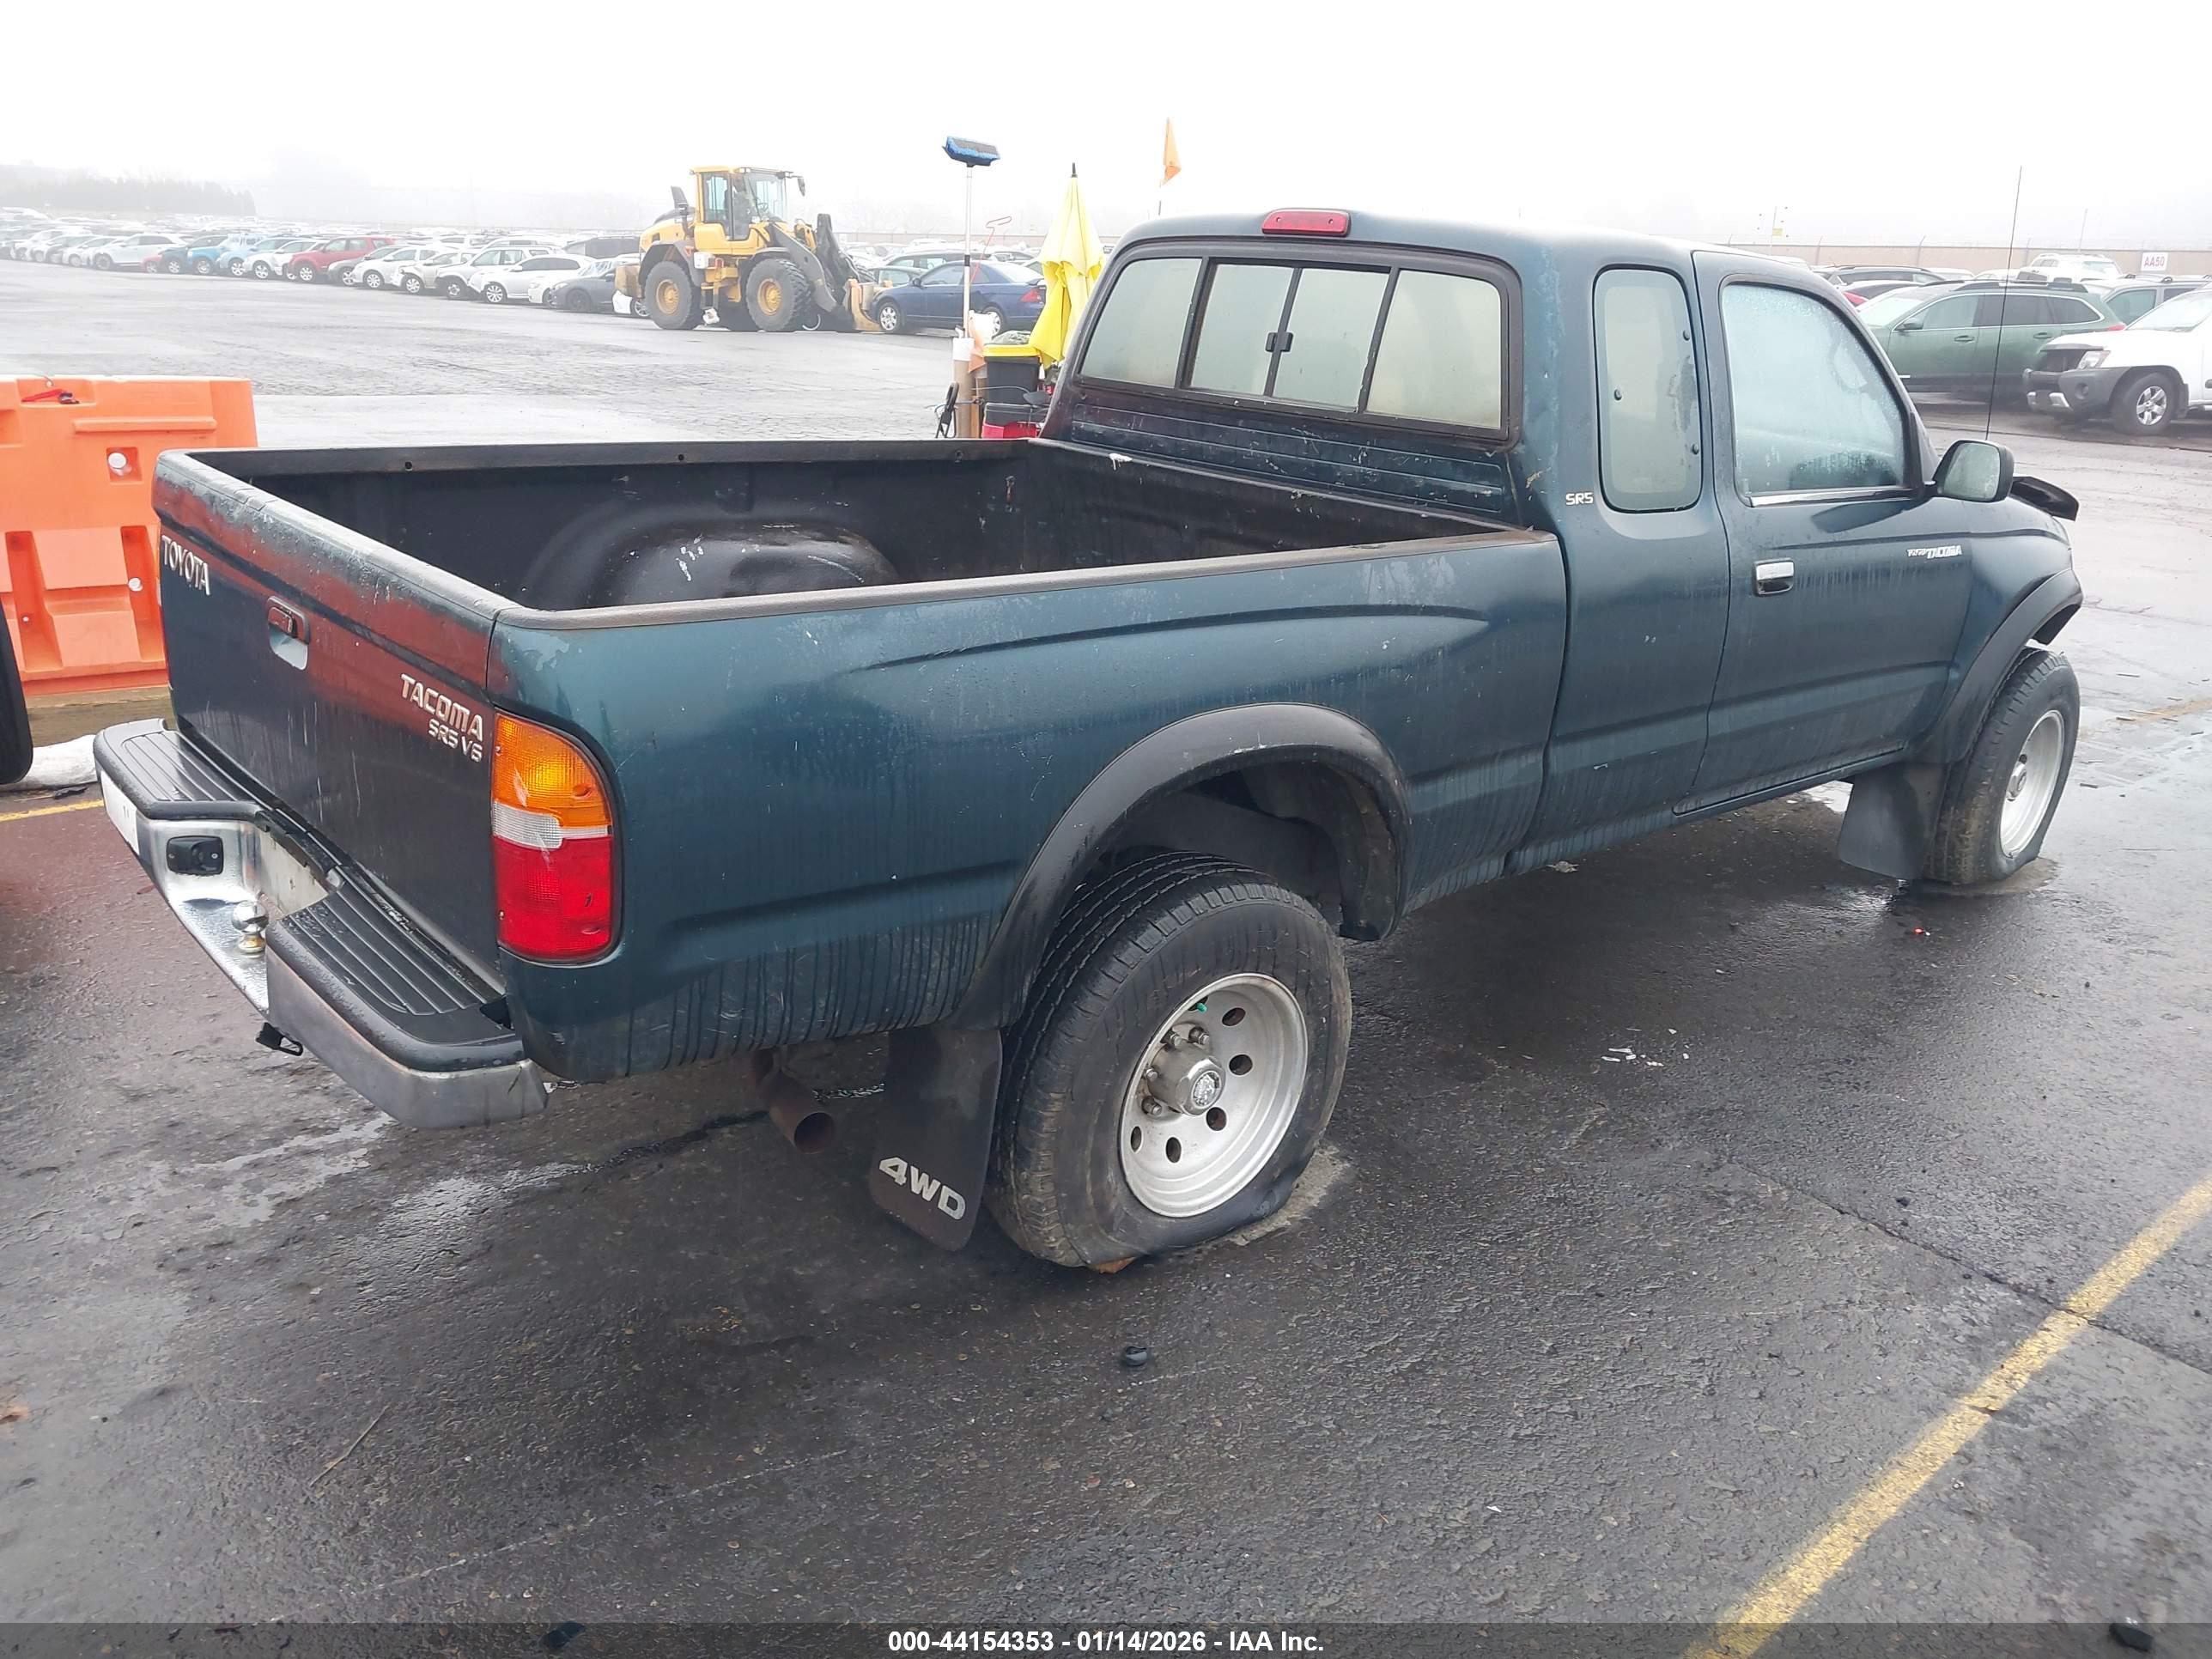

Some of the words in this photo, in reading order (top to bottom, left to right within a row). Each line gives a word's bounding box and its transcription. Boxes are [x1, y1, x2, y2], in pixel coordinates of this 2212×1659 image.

[2143, 256, 2165, 267] AA50
[1565, 492, 1594, 506] SR5
[161, 534, 211, 596] TOYOTA
[400, 673, 484, 741] TACOMA
[428, 718, 459, 750] SR5
[461, 734, 483, 763] V6
[878, 1156, 966, 1220] 4WD
